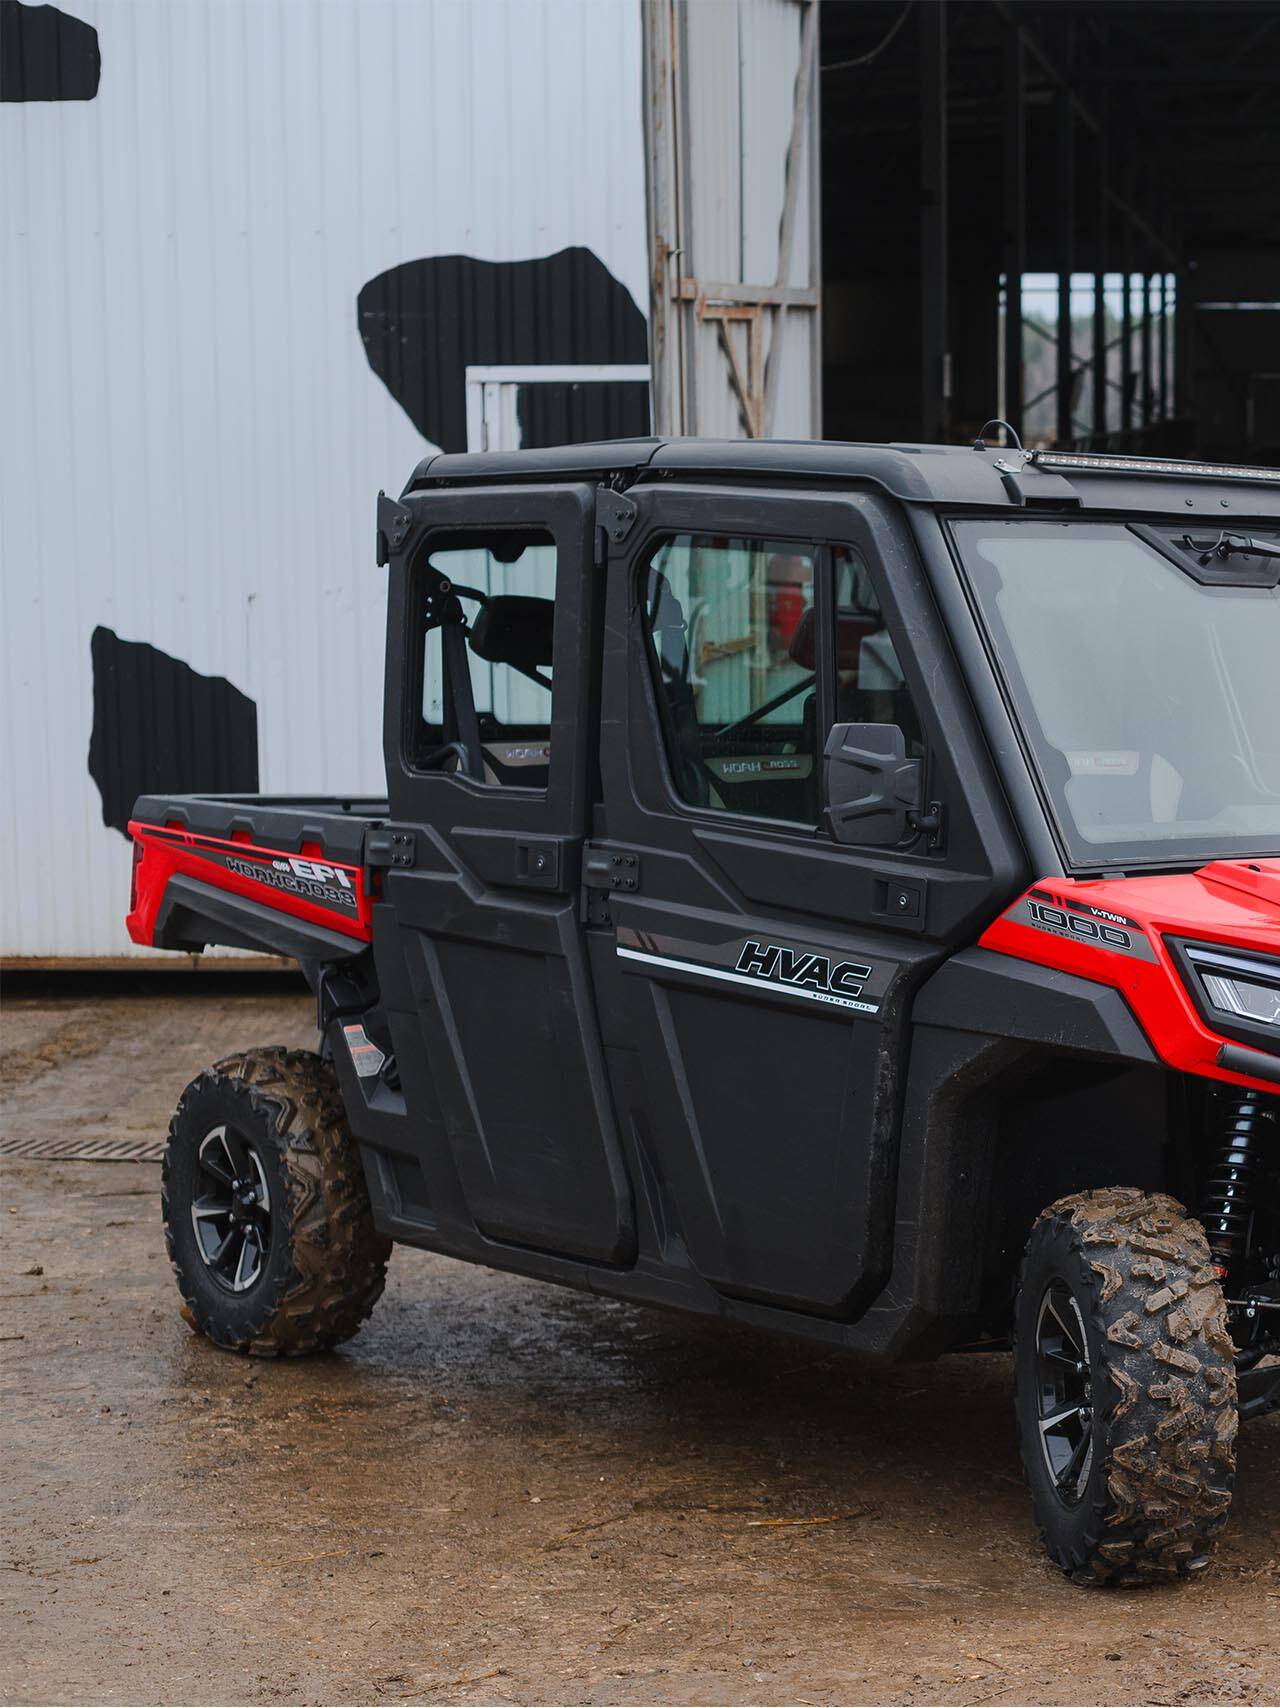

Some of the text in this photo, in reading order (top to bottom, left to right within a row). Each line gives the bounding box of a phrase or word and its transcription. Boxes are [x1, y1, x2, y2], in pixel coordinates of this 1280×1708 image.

[1026, 899, 1133, 951] 1000
[1090, 907, 1127, 925] V-TWIN
[735, 940, 872, 997] HVAC
